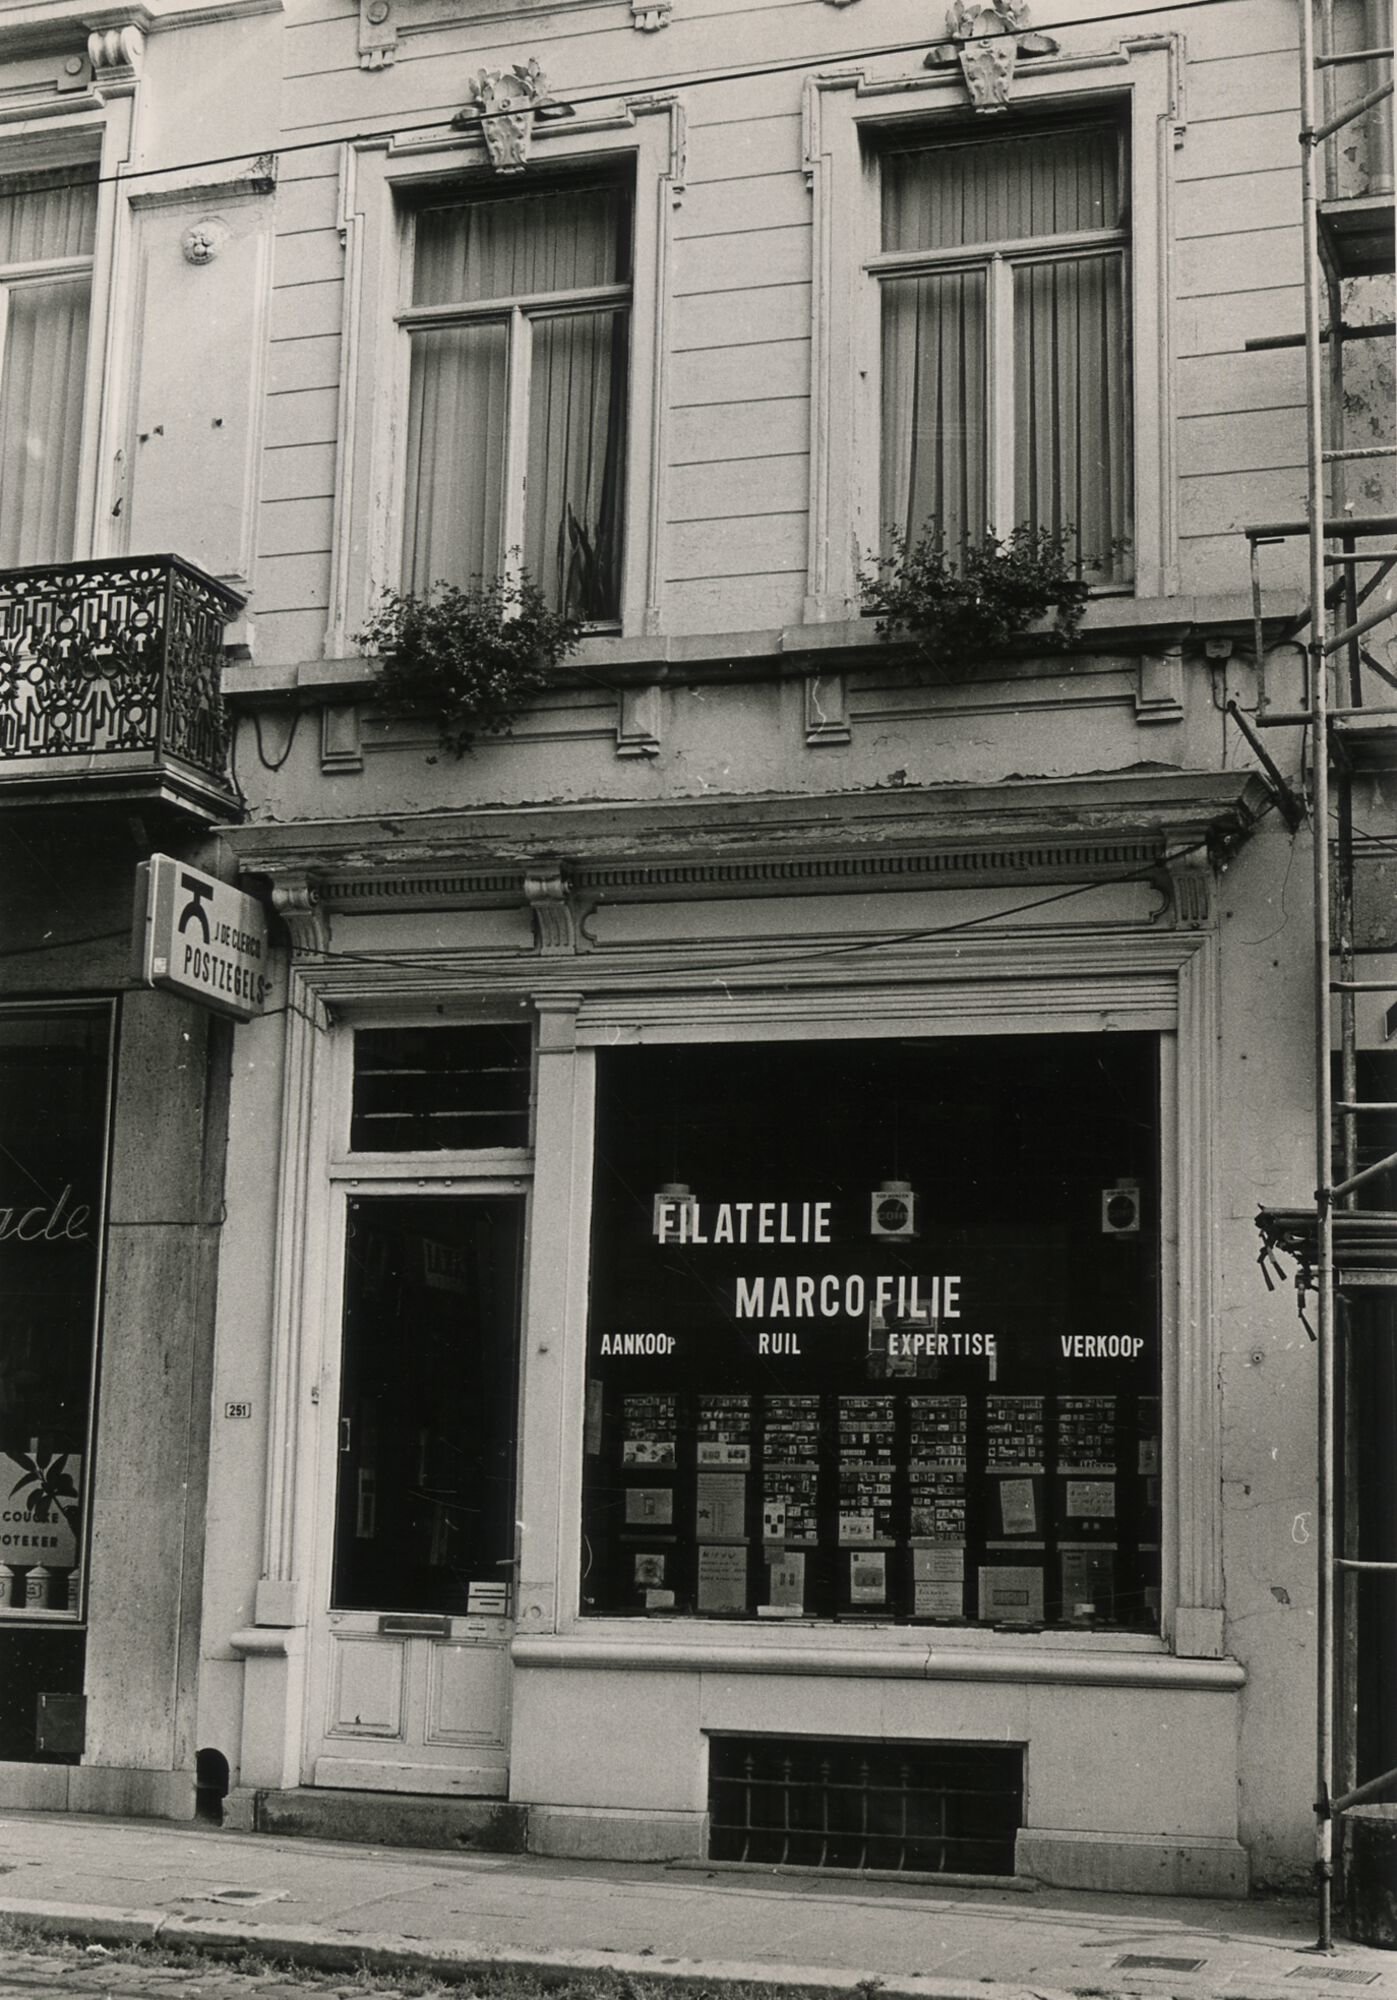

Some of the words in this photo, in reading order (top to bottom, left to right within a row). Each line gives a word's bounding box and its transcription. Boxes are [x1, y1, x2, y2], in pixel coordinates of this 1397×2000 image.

[221, 924, 230, 946] DE
[184, 944, 265, 1004] POSTZEGELS
[658, 1203, 831, 1244] FILATELIE
[600, 1333, 676, 1355] AANKOOP
[758, 1333, 801, 1355] RUIL
[888, 1333, 995, 1356] EXPERTISE
[1061, 1335, 1144, 1357] VERKOOP
[229, 1404, 246, 1416] 251
[0, 1535, 58, 1548] OTEKER
